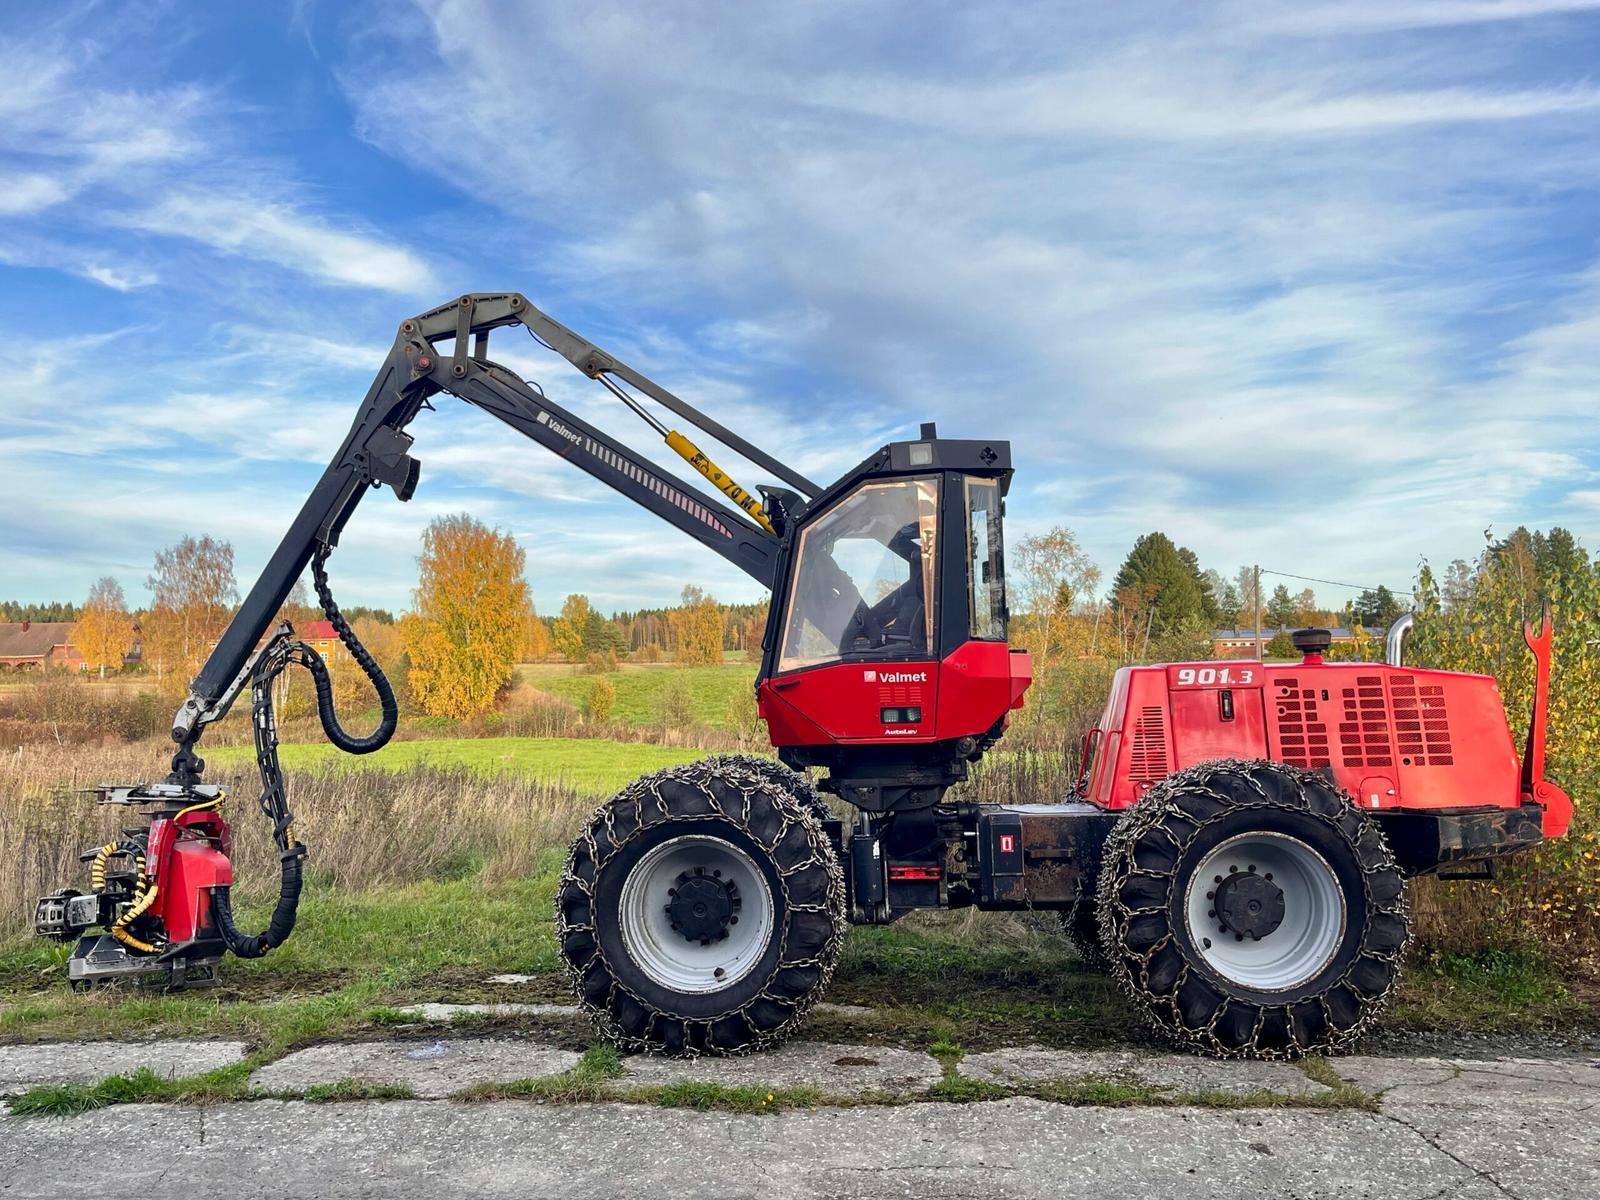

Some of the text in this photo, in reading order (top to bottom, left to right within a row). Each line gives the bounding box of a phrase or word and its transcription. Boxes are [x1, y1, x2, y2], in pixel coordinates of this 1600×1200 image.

[548, 418, 583, 446] Valmet
[723, 480, 757, 511] 70 M
[879, 671, 928, 683] Valmet
[1177, 668, 1253, 685] 901.3
